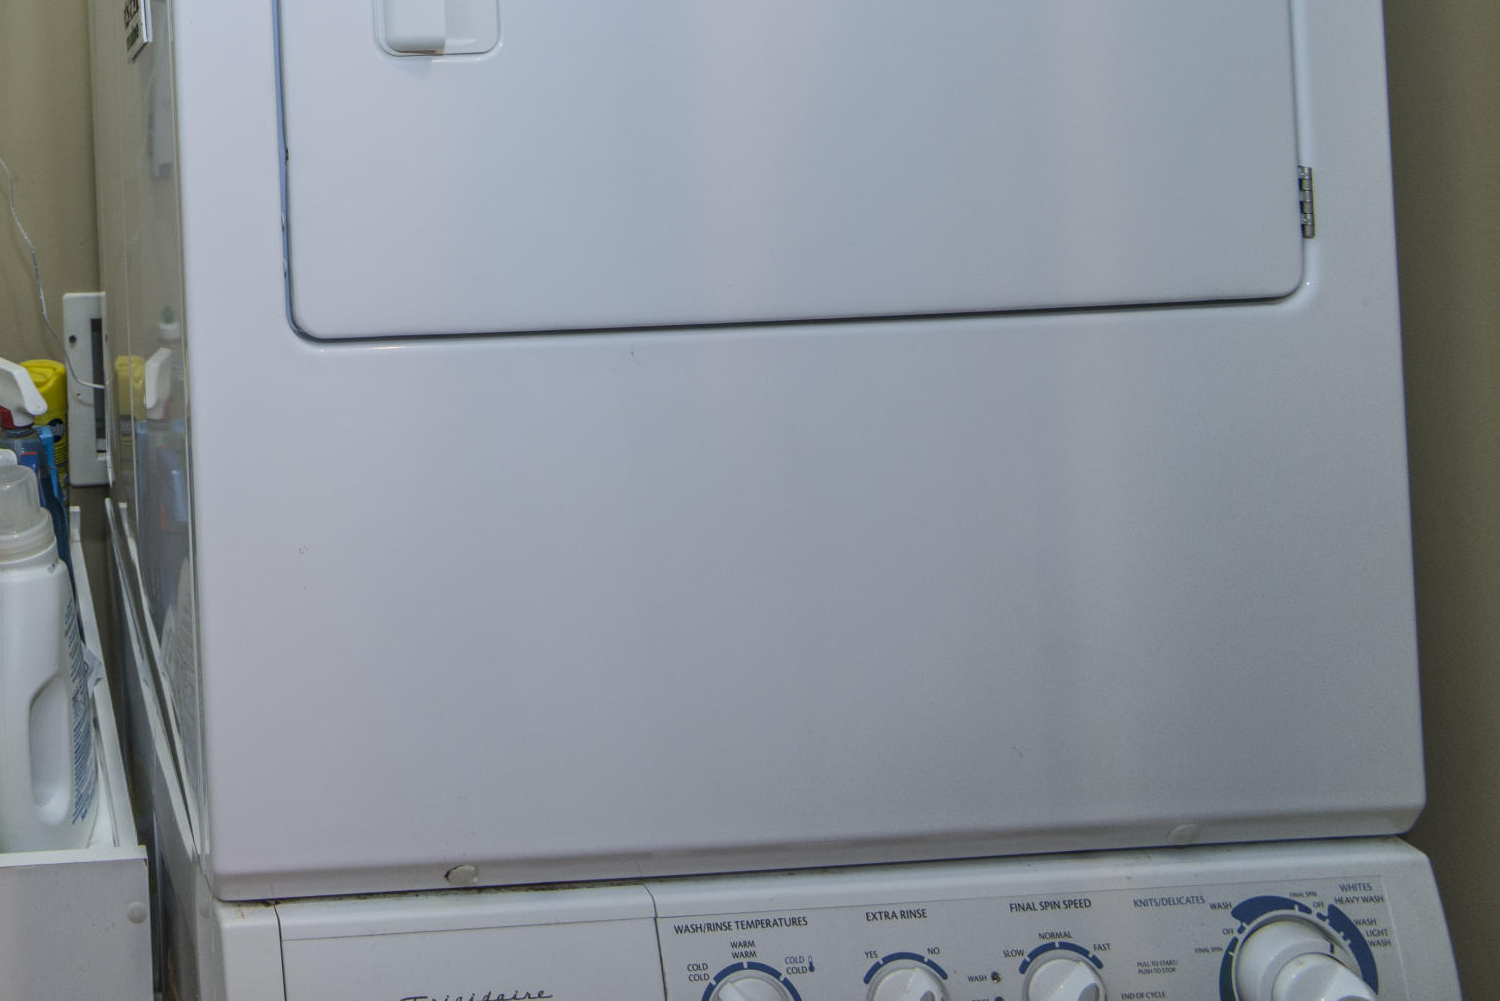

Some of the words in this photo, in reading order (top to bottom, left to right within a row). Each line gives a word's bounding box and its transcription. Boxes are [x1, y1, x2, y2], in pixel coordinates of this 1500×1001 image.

[1339, 883, 1372, 893] WHITES
[1133, 895, 1205, 909] KNITS/DELICATES
[1334, 897, 1360, 905] HEAVY
[1361, 895, 1384, 903] WASH
[1010, 902, 1034, 913] FINAL
[1035, 901, 1060, 911] SPIN
[1062, 899, 1092, 909] SPEED
[1209, 902, 1232, 911] WASH
[1313, 901, 1324, 909] OFF
[866, 911, 897, 922] EXTRA
[899, 909, 928, 920] RINSE
[674, 921, 733, 935] WASH/RINSE
[734, 917, 808, 931] TEMPERATURES
[1354, 918, 1376, 926] WASH
[1038, 931, 1072, 940] NORMAL
[1222, 927, 1235, 935] OFF
[1366, 929, 1388, 937] LIGHT
[730, 940, 756, 949] WARM
[1094, 943, 1111, 951] FAST
[1368, 939, 1392, 947] WASH
[732, 950, 757, 959] WARM
[864, 951, 878, 959] YES
[927, 947, 940, 955] NO
[1003, 949, 1024, 958] SLOW
[784, 955, 804, 965] COLD
[687, 963, 708, 971] COLD
[786, 965, 808, 975] COLD
[688, 973, 710, 982] COLD
[967, 975, 988, 983] WASH
